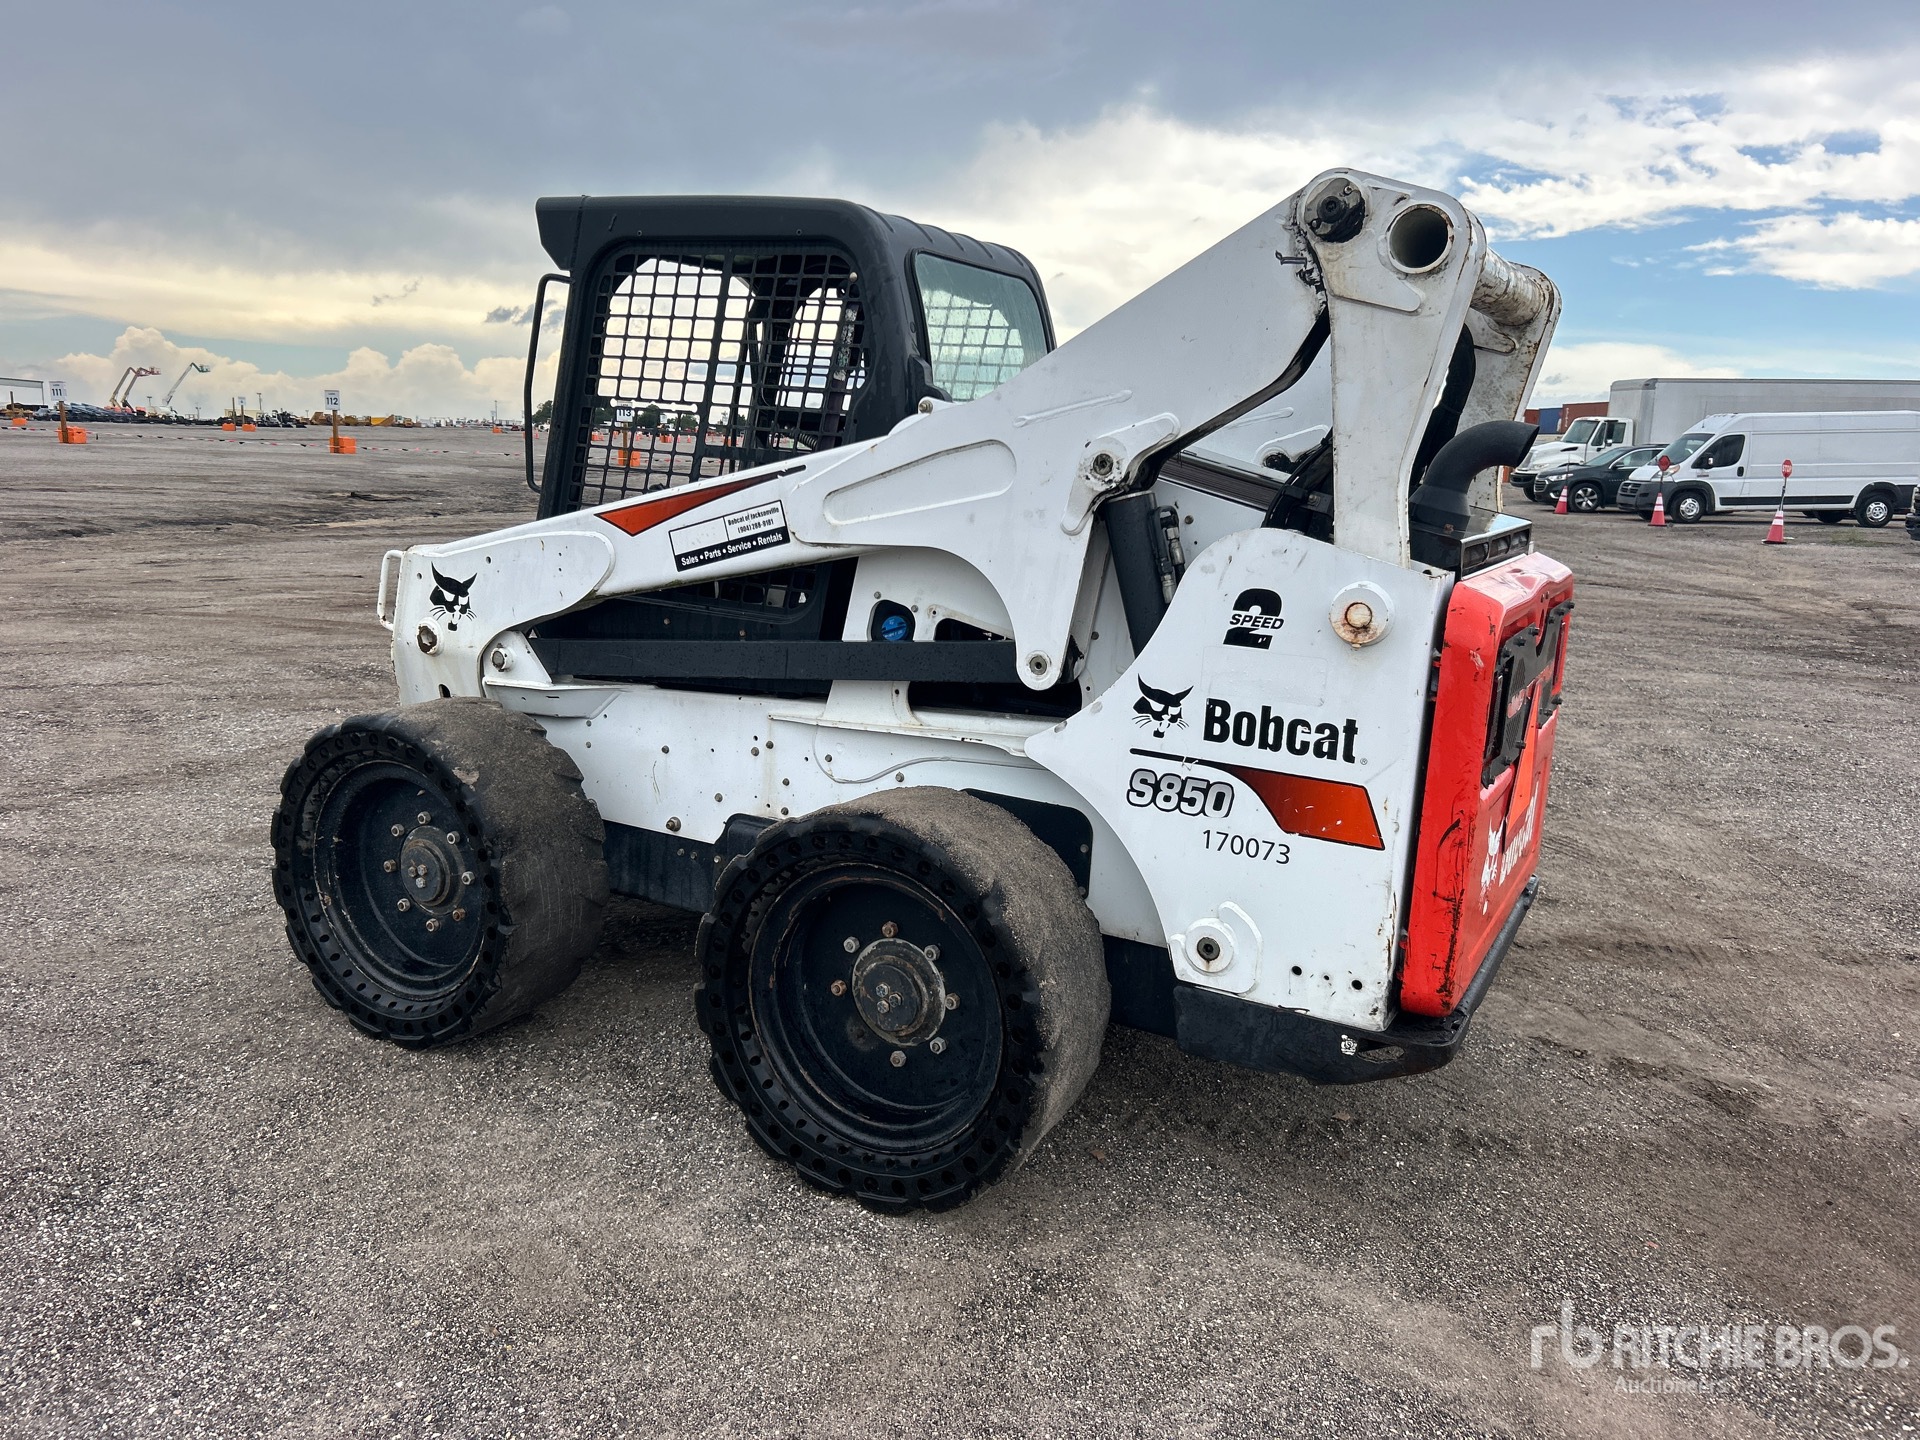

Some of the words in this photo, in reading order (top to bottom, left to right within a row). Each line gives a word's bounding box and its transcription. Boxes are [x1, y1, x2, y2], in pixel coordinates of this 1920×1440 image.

[51, 388, 62, 396] 111
[326, 397, 338, 405] 112
[618, 408, 631, 416] 113
[727, 516, 744, 526] Bobcat
[681, 555, 699, 566] Sales
[704, 548, 722, 560] Parts
[727, 541, 752, 554] Service
[757, 532, 783, 546] Rentals
[1223, 588, 1282, 650] 2
[1229, 613, 1284, 630] SPEED
[1203, 697, 1359, 764] Bobcat
[1126, 768, 1235, 819] S850
[1202, 829, 1291, 865] 170073
